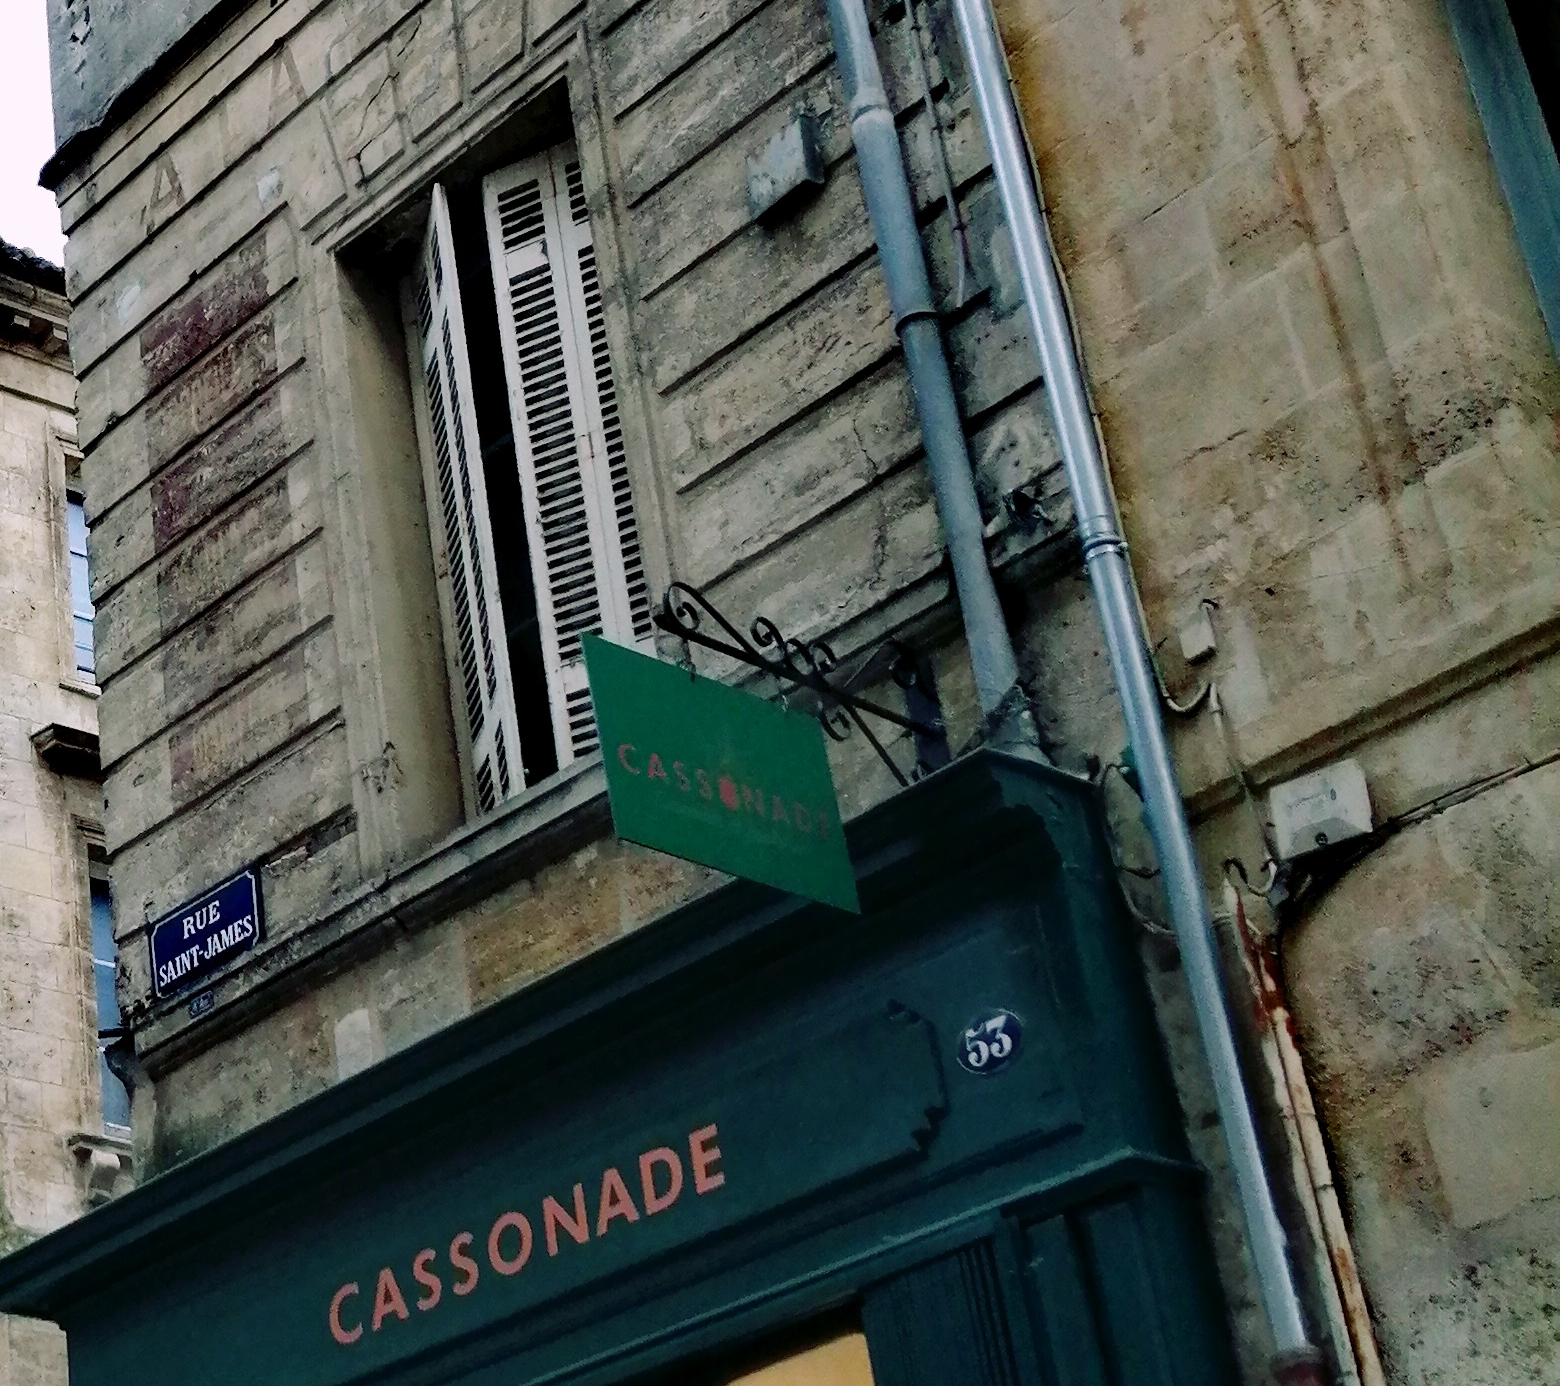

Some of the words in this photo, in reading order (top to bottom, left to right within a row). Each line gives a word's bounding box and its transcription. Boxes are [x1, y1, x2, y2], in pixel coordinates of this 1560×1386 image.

[617, 743, 831, 840] CASSONADE
[159, 915, 253, 987] SAINT-JAMES
[182, 900, 221, 940] RUE
[965, 1015, 1014, 1070] 53
[328, 1123, 726, 1346] CASSONADE
